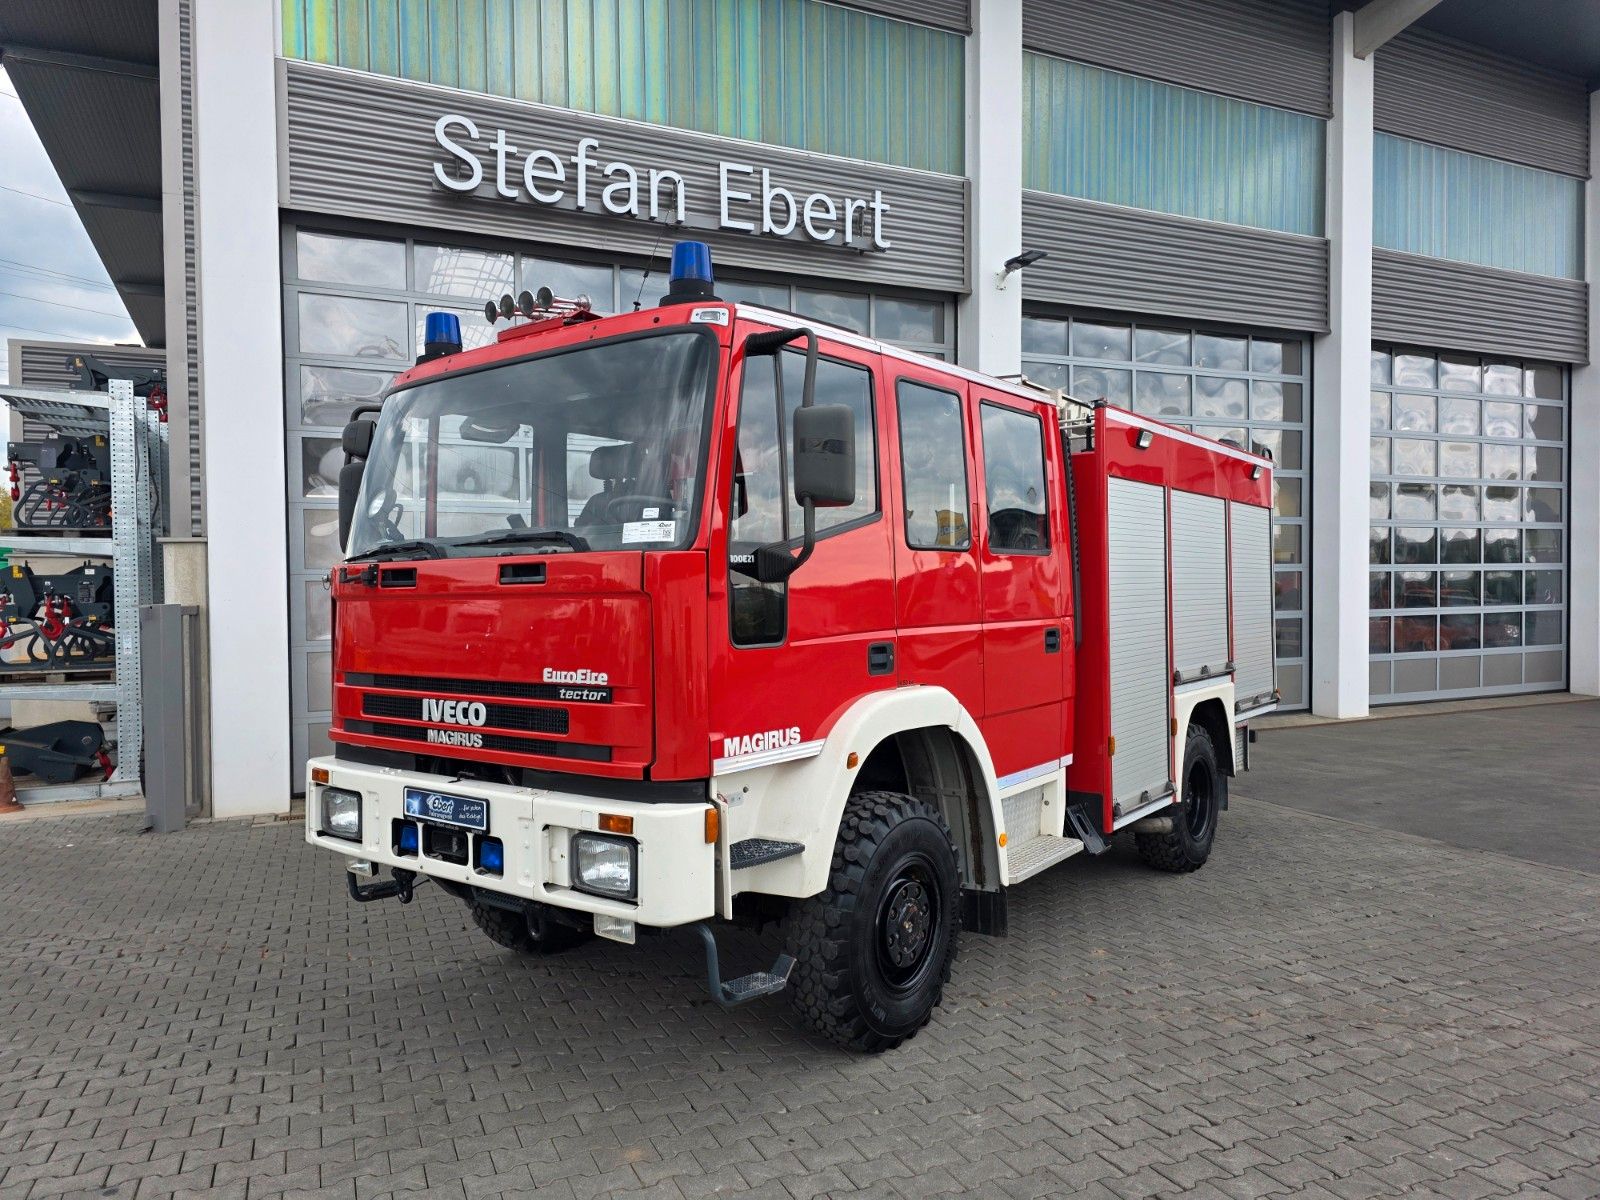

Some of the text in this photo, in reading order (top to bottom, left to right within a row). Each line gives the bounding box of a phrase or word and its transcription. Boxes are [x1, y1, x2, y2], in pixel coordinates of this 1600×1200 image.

[433, 114, 892, 250] Stefan Ebert
[542, 667, 608, 686] EuroFire
[559, 687, 607, 701] tector
[422, 698, 487, 727] IVECO
[427, 729, 483, 748] MAGIRUS
[723, 726, 801, 758] MAGIRUS
[431, 796, 454, 814] Ebert
